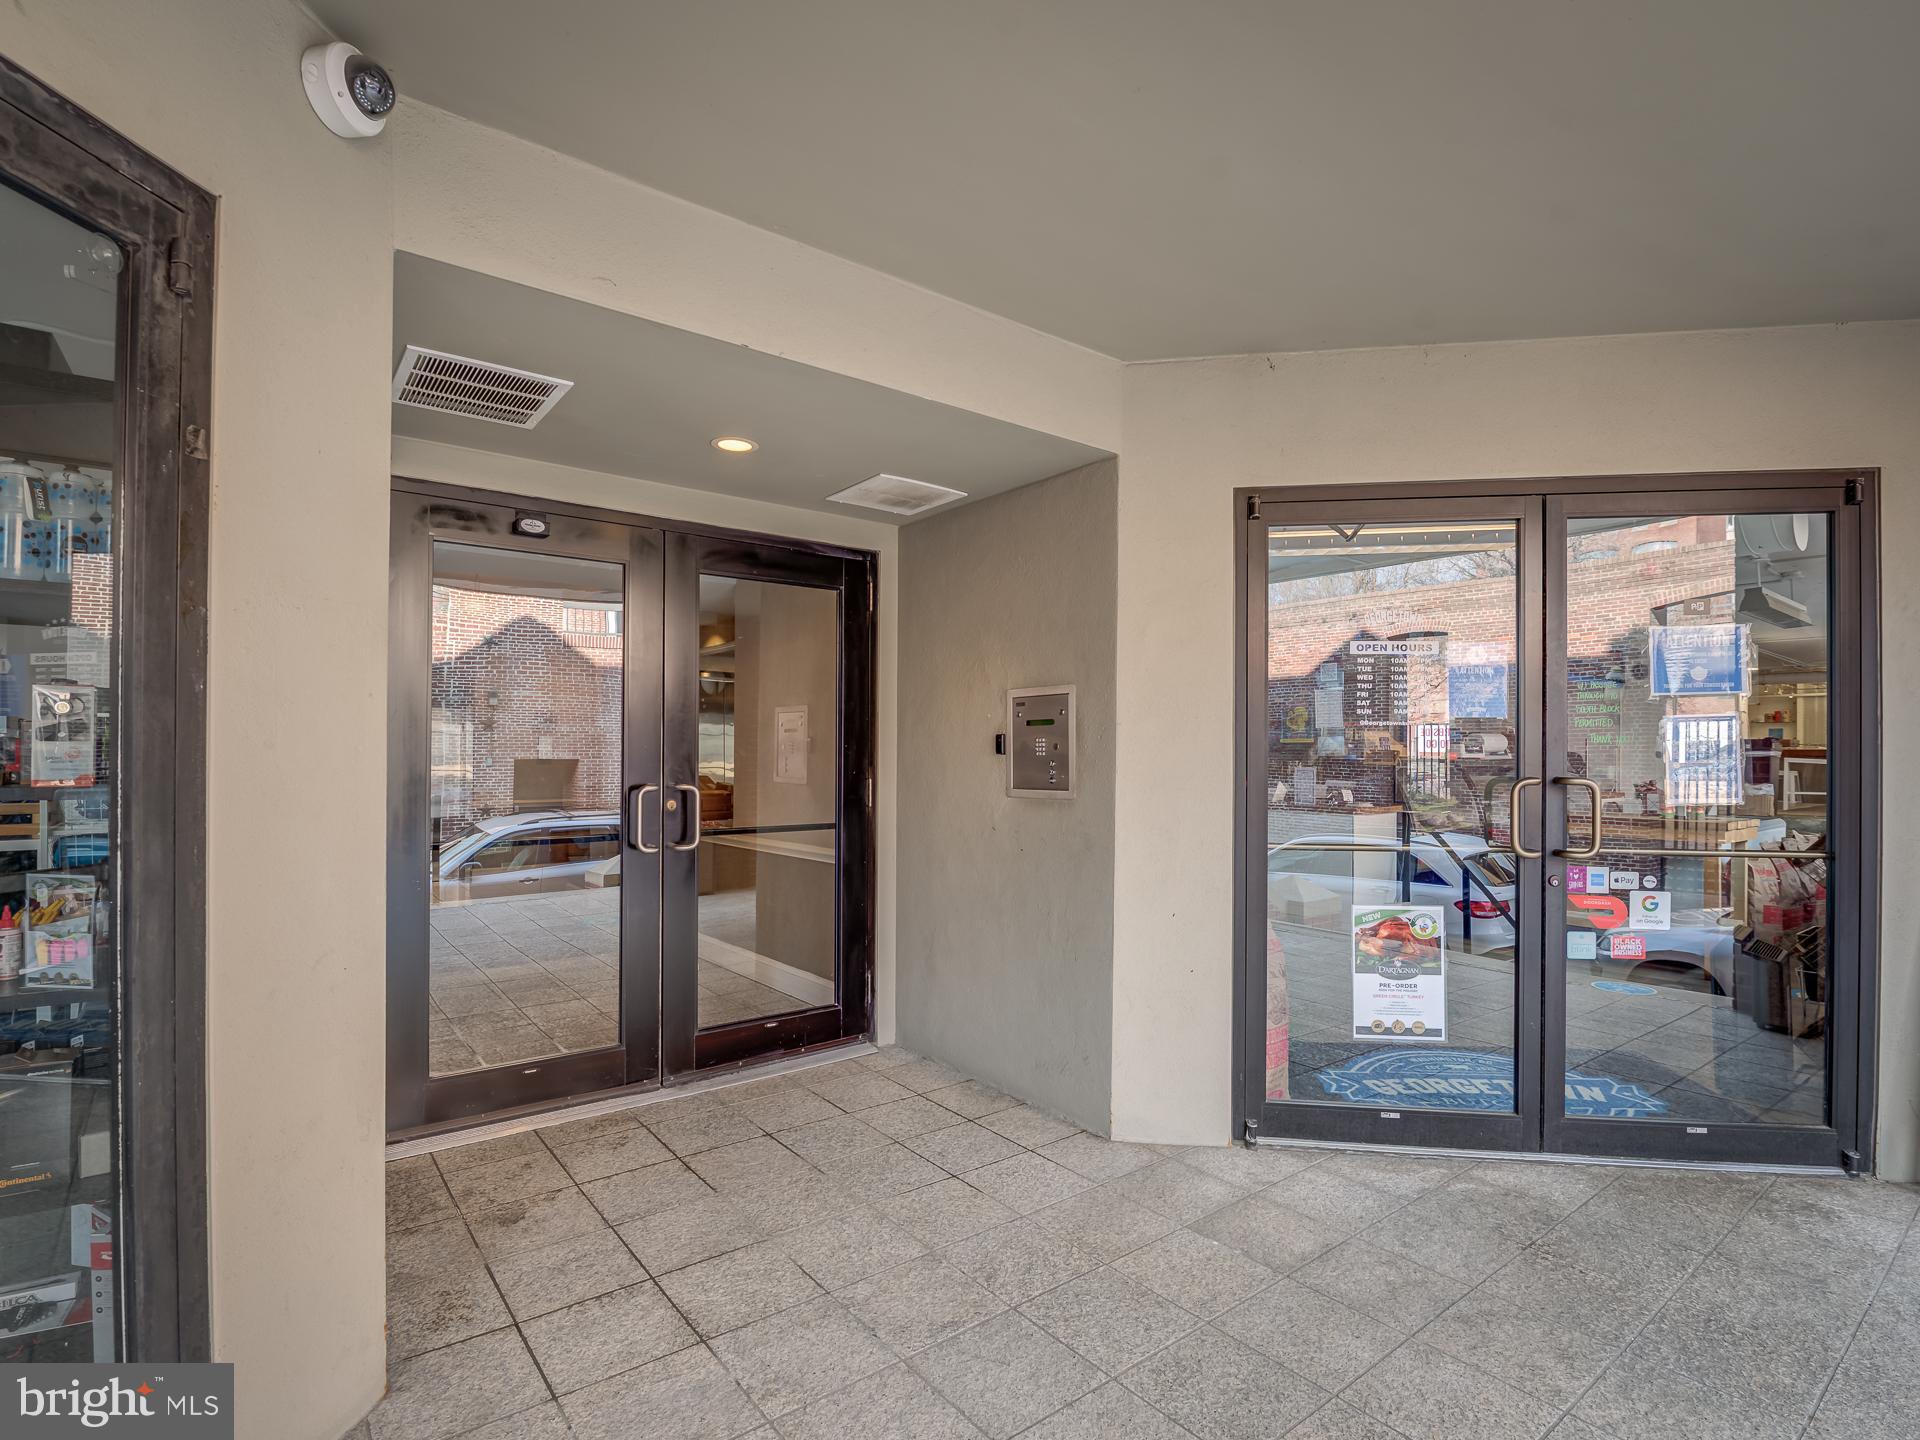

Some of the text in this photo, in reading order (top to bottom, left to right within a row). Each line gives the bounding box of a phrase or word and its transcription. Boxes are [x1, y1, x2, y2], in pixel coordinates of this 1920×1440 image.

[1356, 644, 1433, 652] OPEN HOURS
[1620, 876, 1635, 886] Pay
[1361, 911, 1382, 923] NEW
